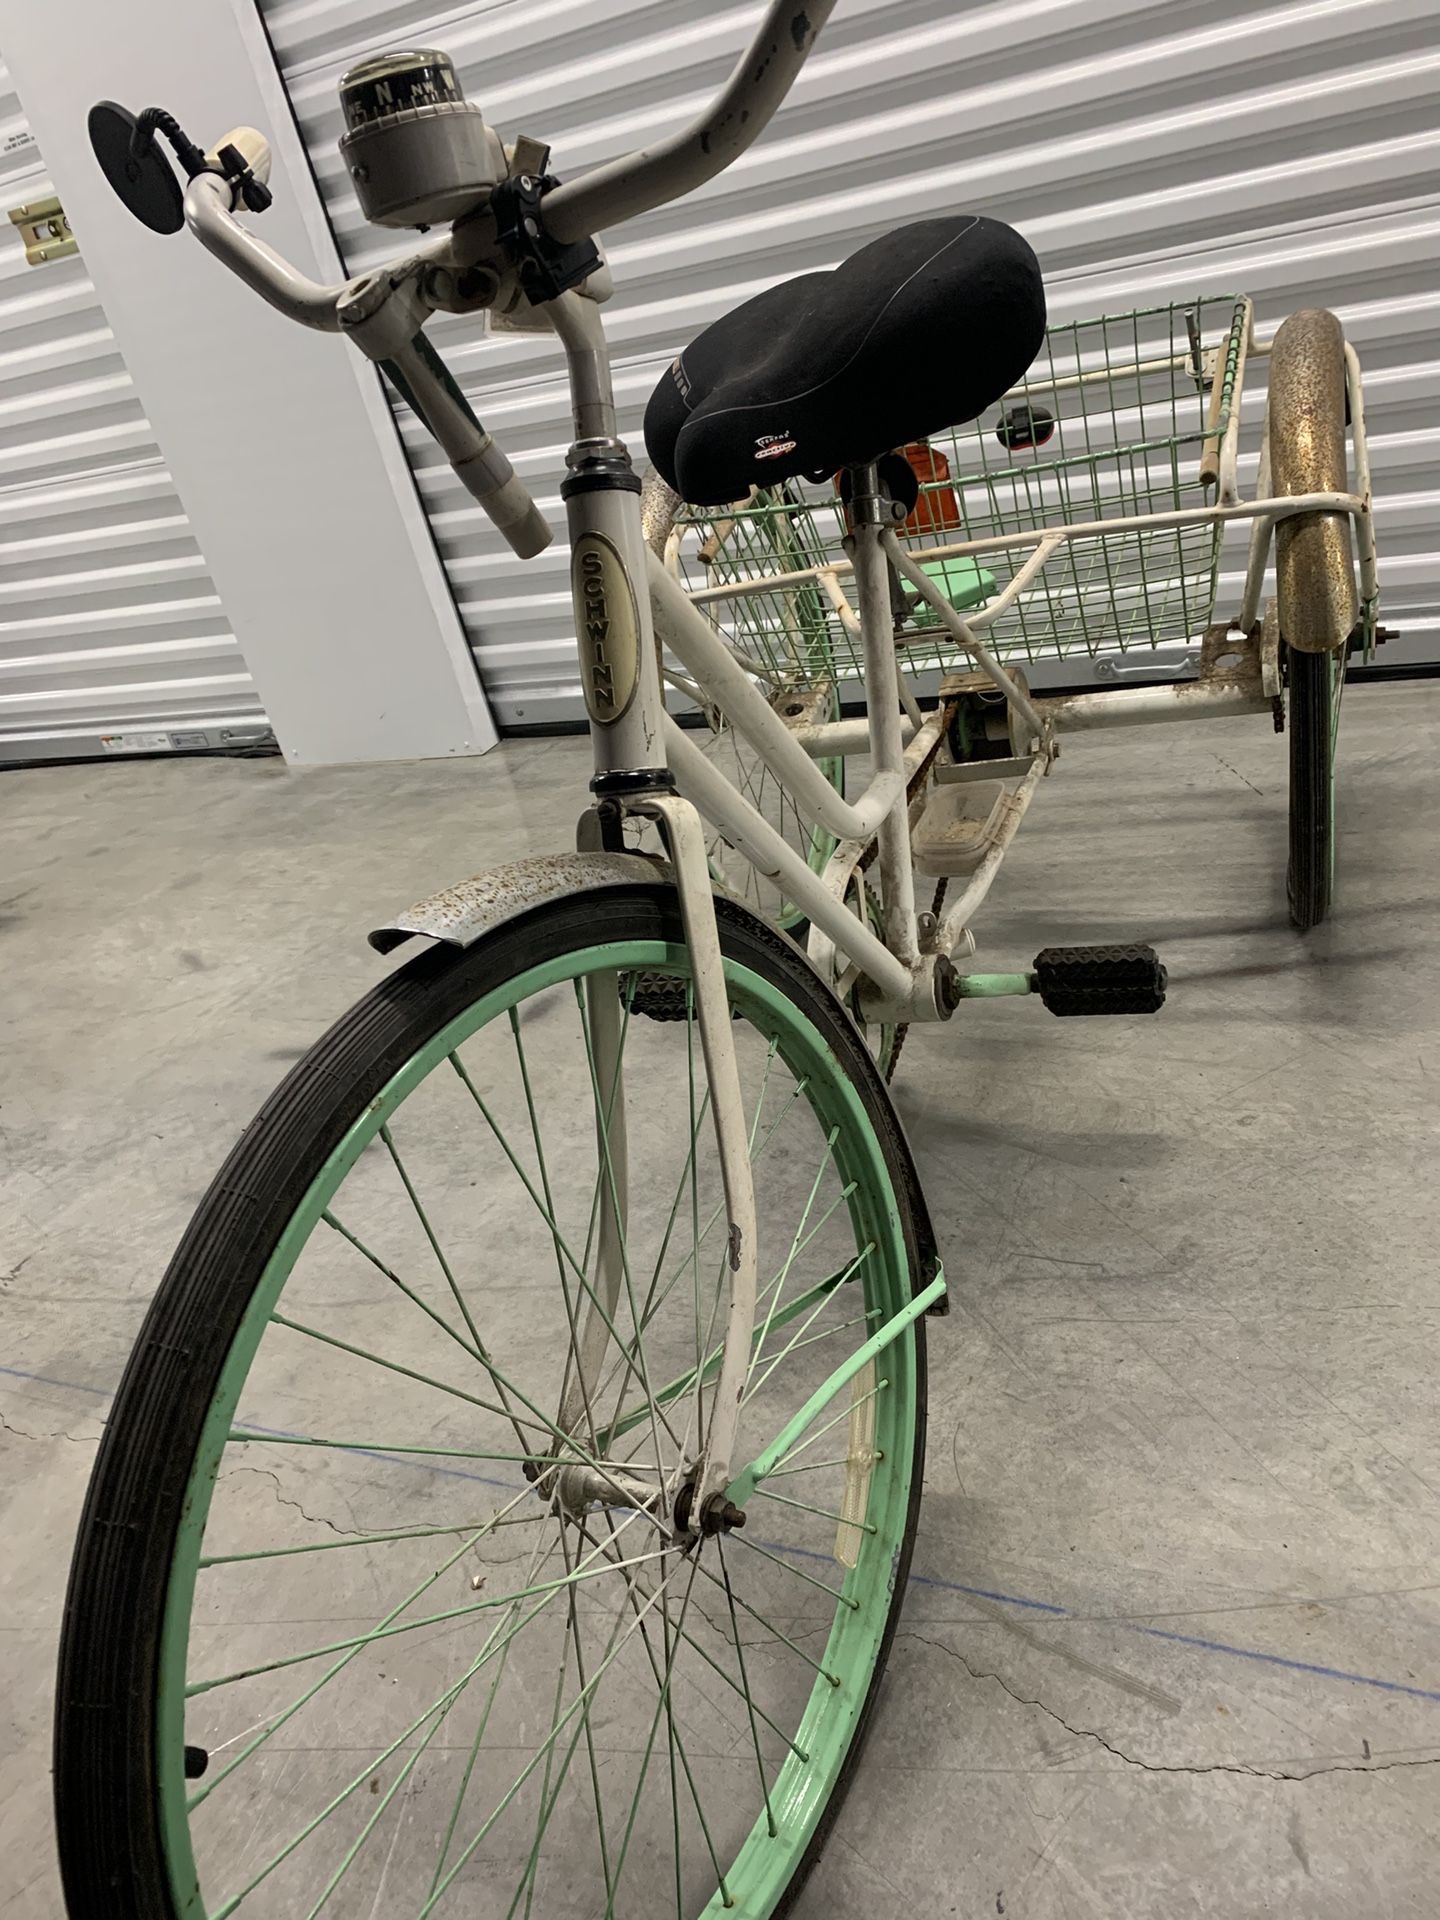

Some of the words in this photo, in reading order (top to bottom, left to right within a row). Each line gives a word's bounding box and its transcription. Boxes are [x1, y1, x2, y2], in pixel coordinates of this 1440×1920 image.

[375, 81, 394, 105] N
[410, 81, 435, 96] NW
[581, 551, 616, 709] SCHWINN
